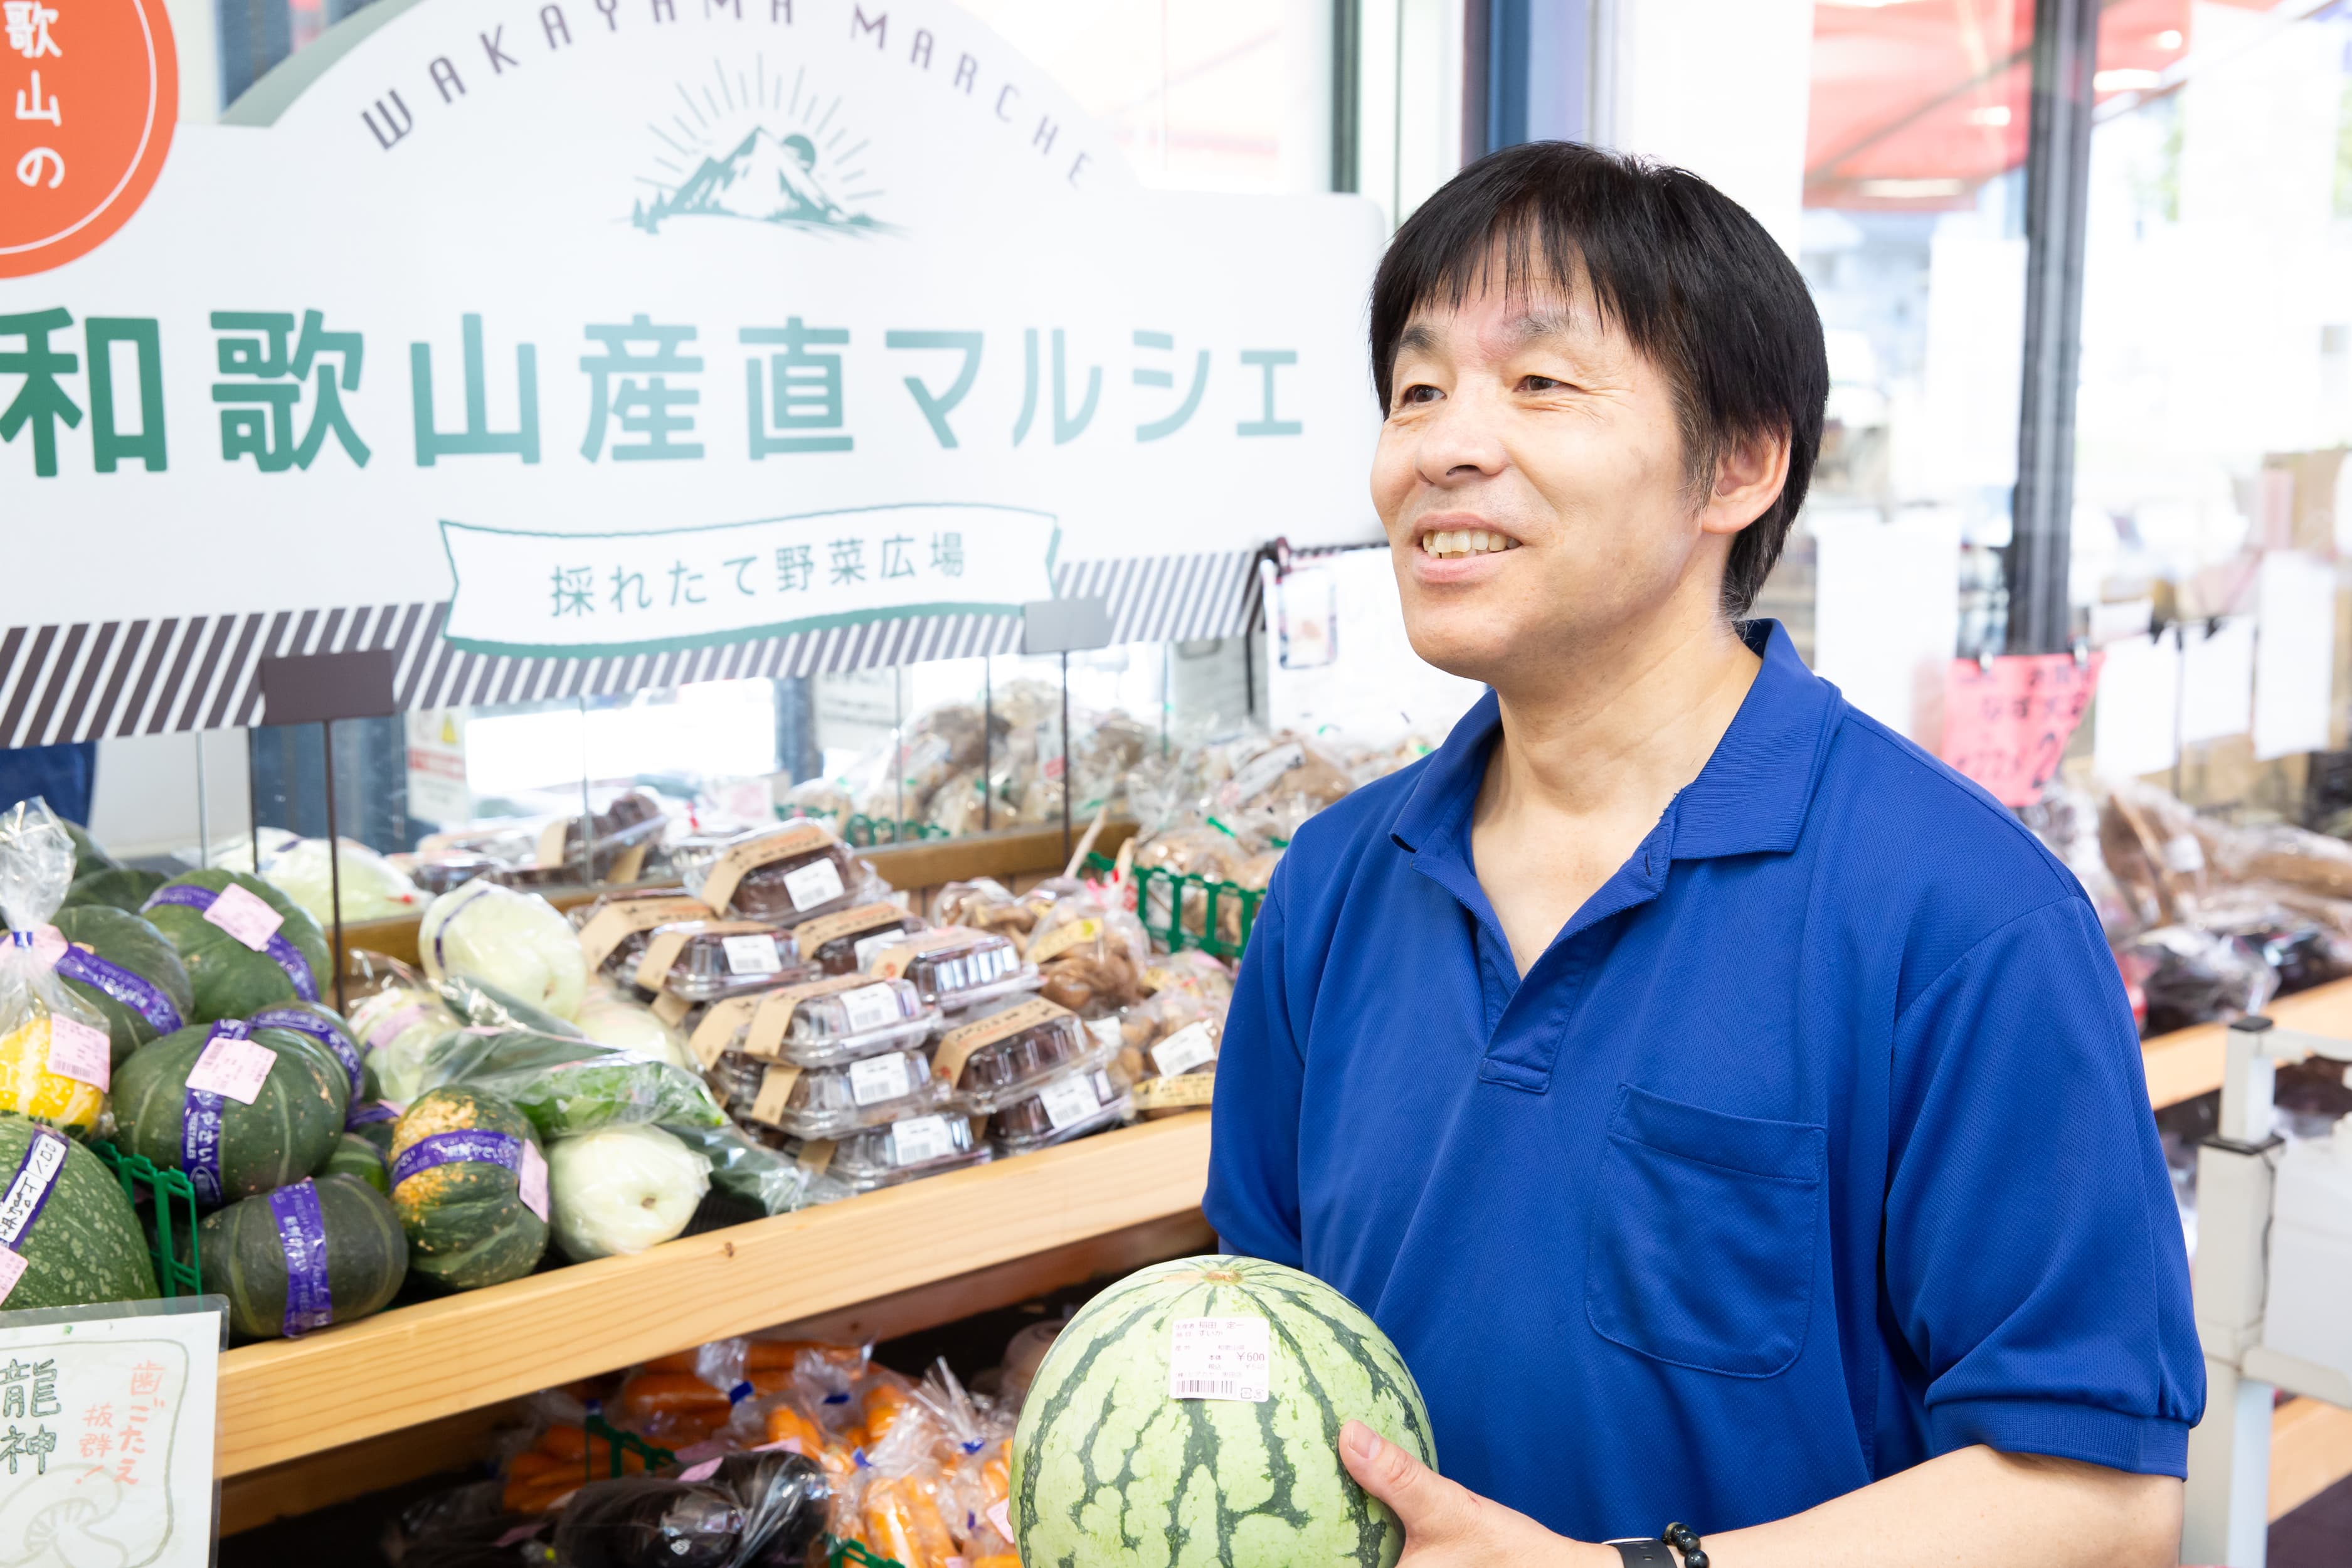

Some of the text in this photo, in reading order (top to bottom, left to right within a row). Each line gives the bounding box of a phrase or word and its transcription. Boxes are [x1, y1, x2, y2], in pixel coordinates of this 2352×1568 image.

[3, 0, 66, 189] 歌山の
[850, 3, 1095, 189] MARCHE
[0, 307, 1303, 478] 和歌山産直マルシェ
[549, 531, 965, 618] 採れたて野菜広場
[114, 1359, 166, 1485] 歯ごたえ
